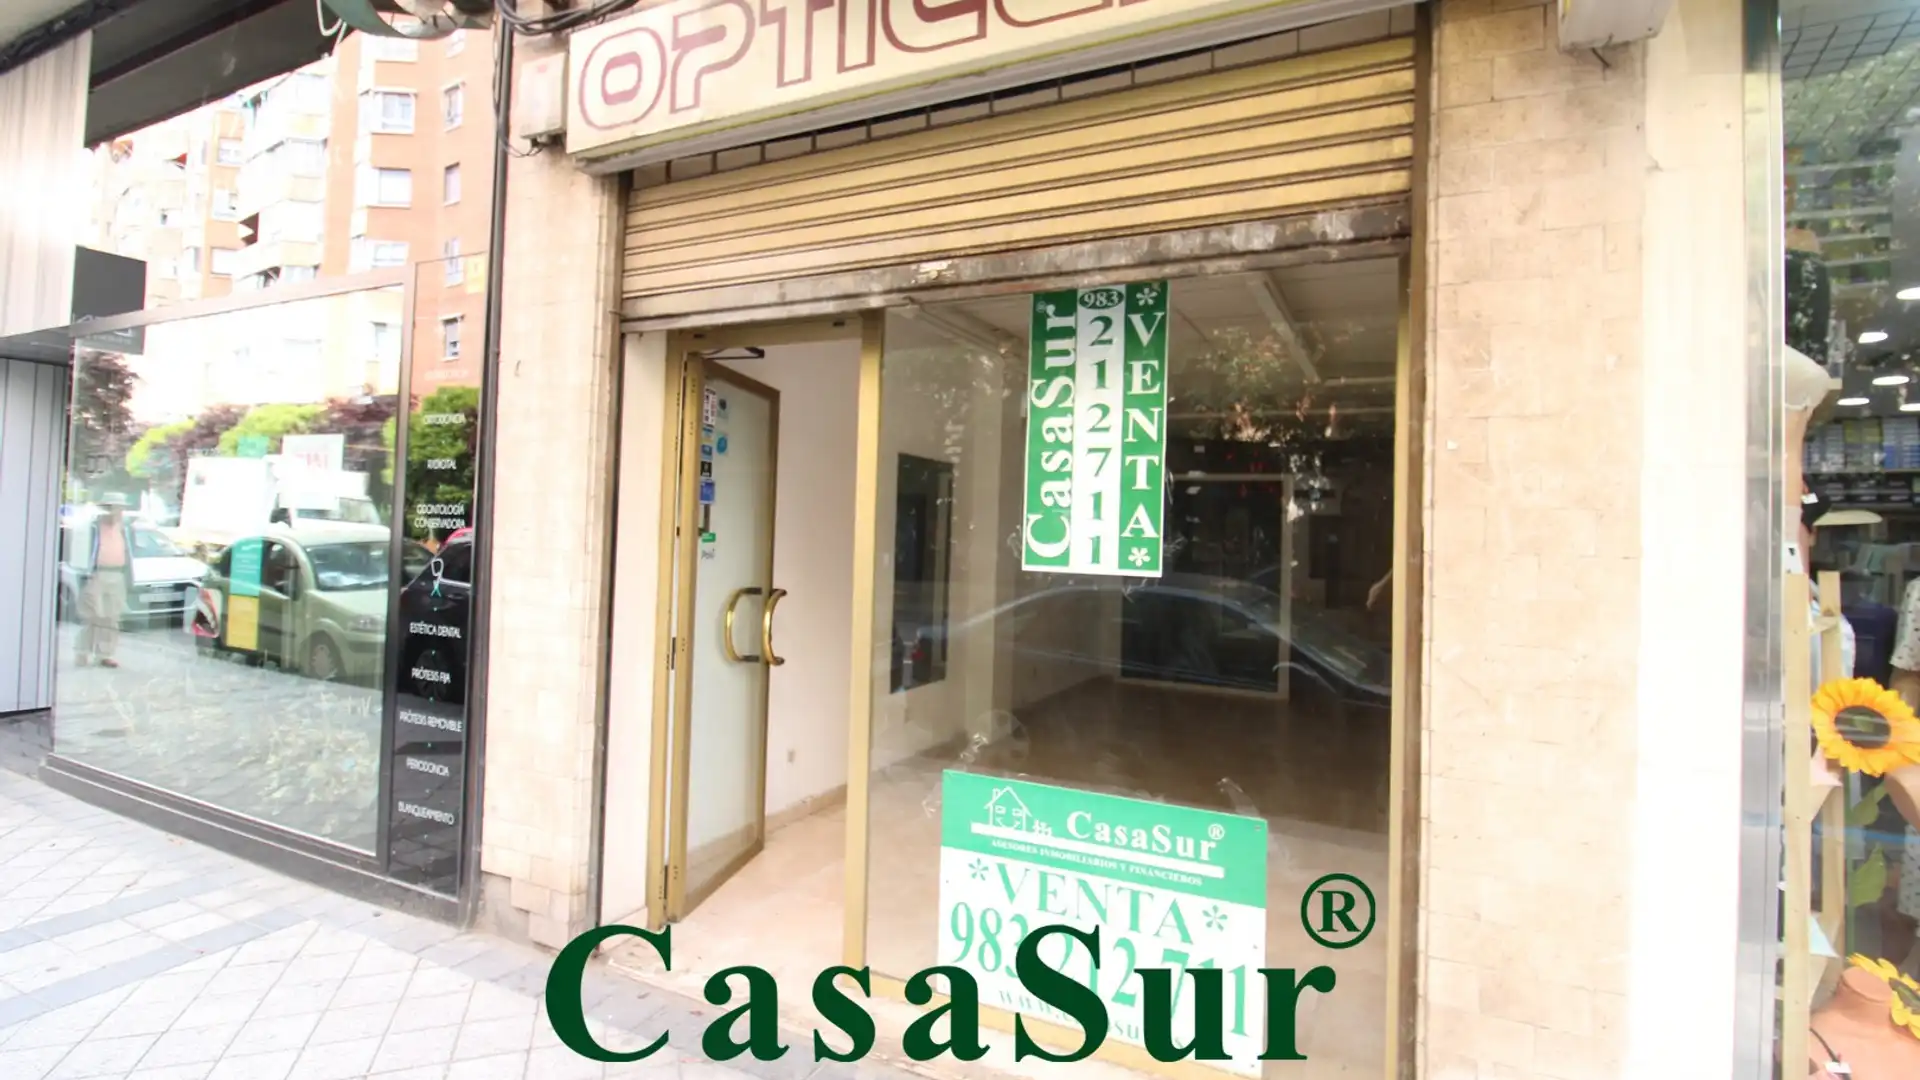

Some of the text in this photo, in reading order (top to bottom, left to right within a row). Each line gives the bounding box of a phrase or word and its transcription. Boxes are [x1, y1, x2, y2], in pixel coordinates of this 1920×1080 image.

[579, 0, 1148, 130] OPTIC
[1084, 291, 1119, 307] 983
[1120, 311, 1165, 539] VENTA
[409, 621, 462, 639] ESTÉTICA DENTAL
[411, 666, 451, 685] PRÓTESIS FIJA
[399, 709, 463, 733] PRÓTESIS REMOVIBLE
[397, 800, 455, 826] BLANQUEAMIENTO
[991, 839, 1039, 855] ASESORES
[1039, 847, 1118, 870] INMOBILIARIOS
[1128, 864, 1204, 887] FINANCIEROS
[994, 862, 1194, 945] VENTA
[1161, 947, 1250, 1038] 71
